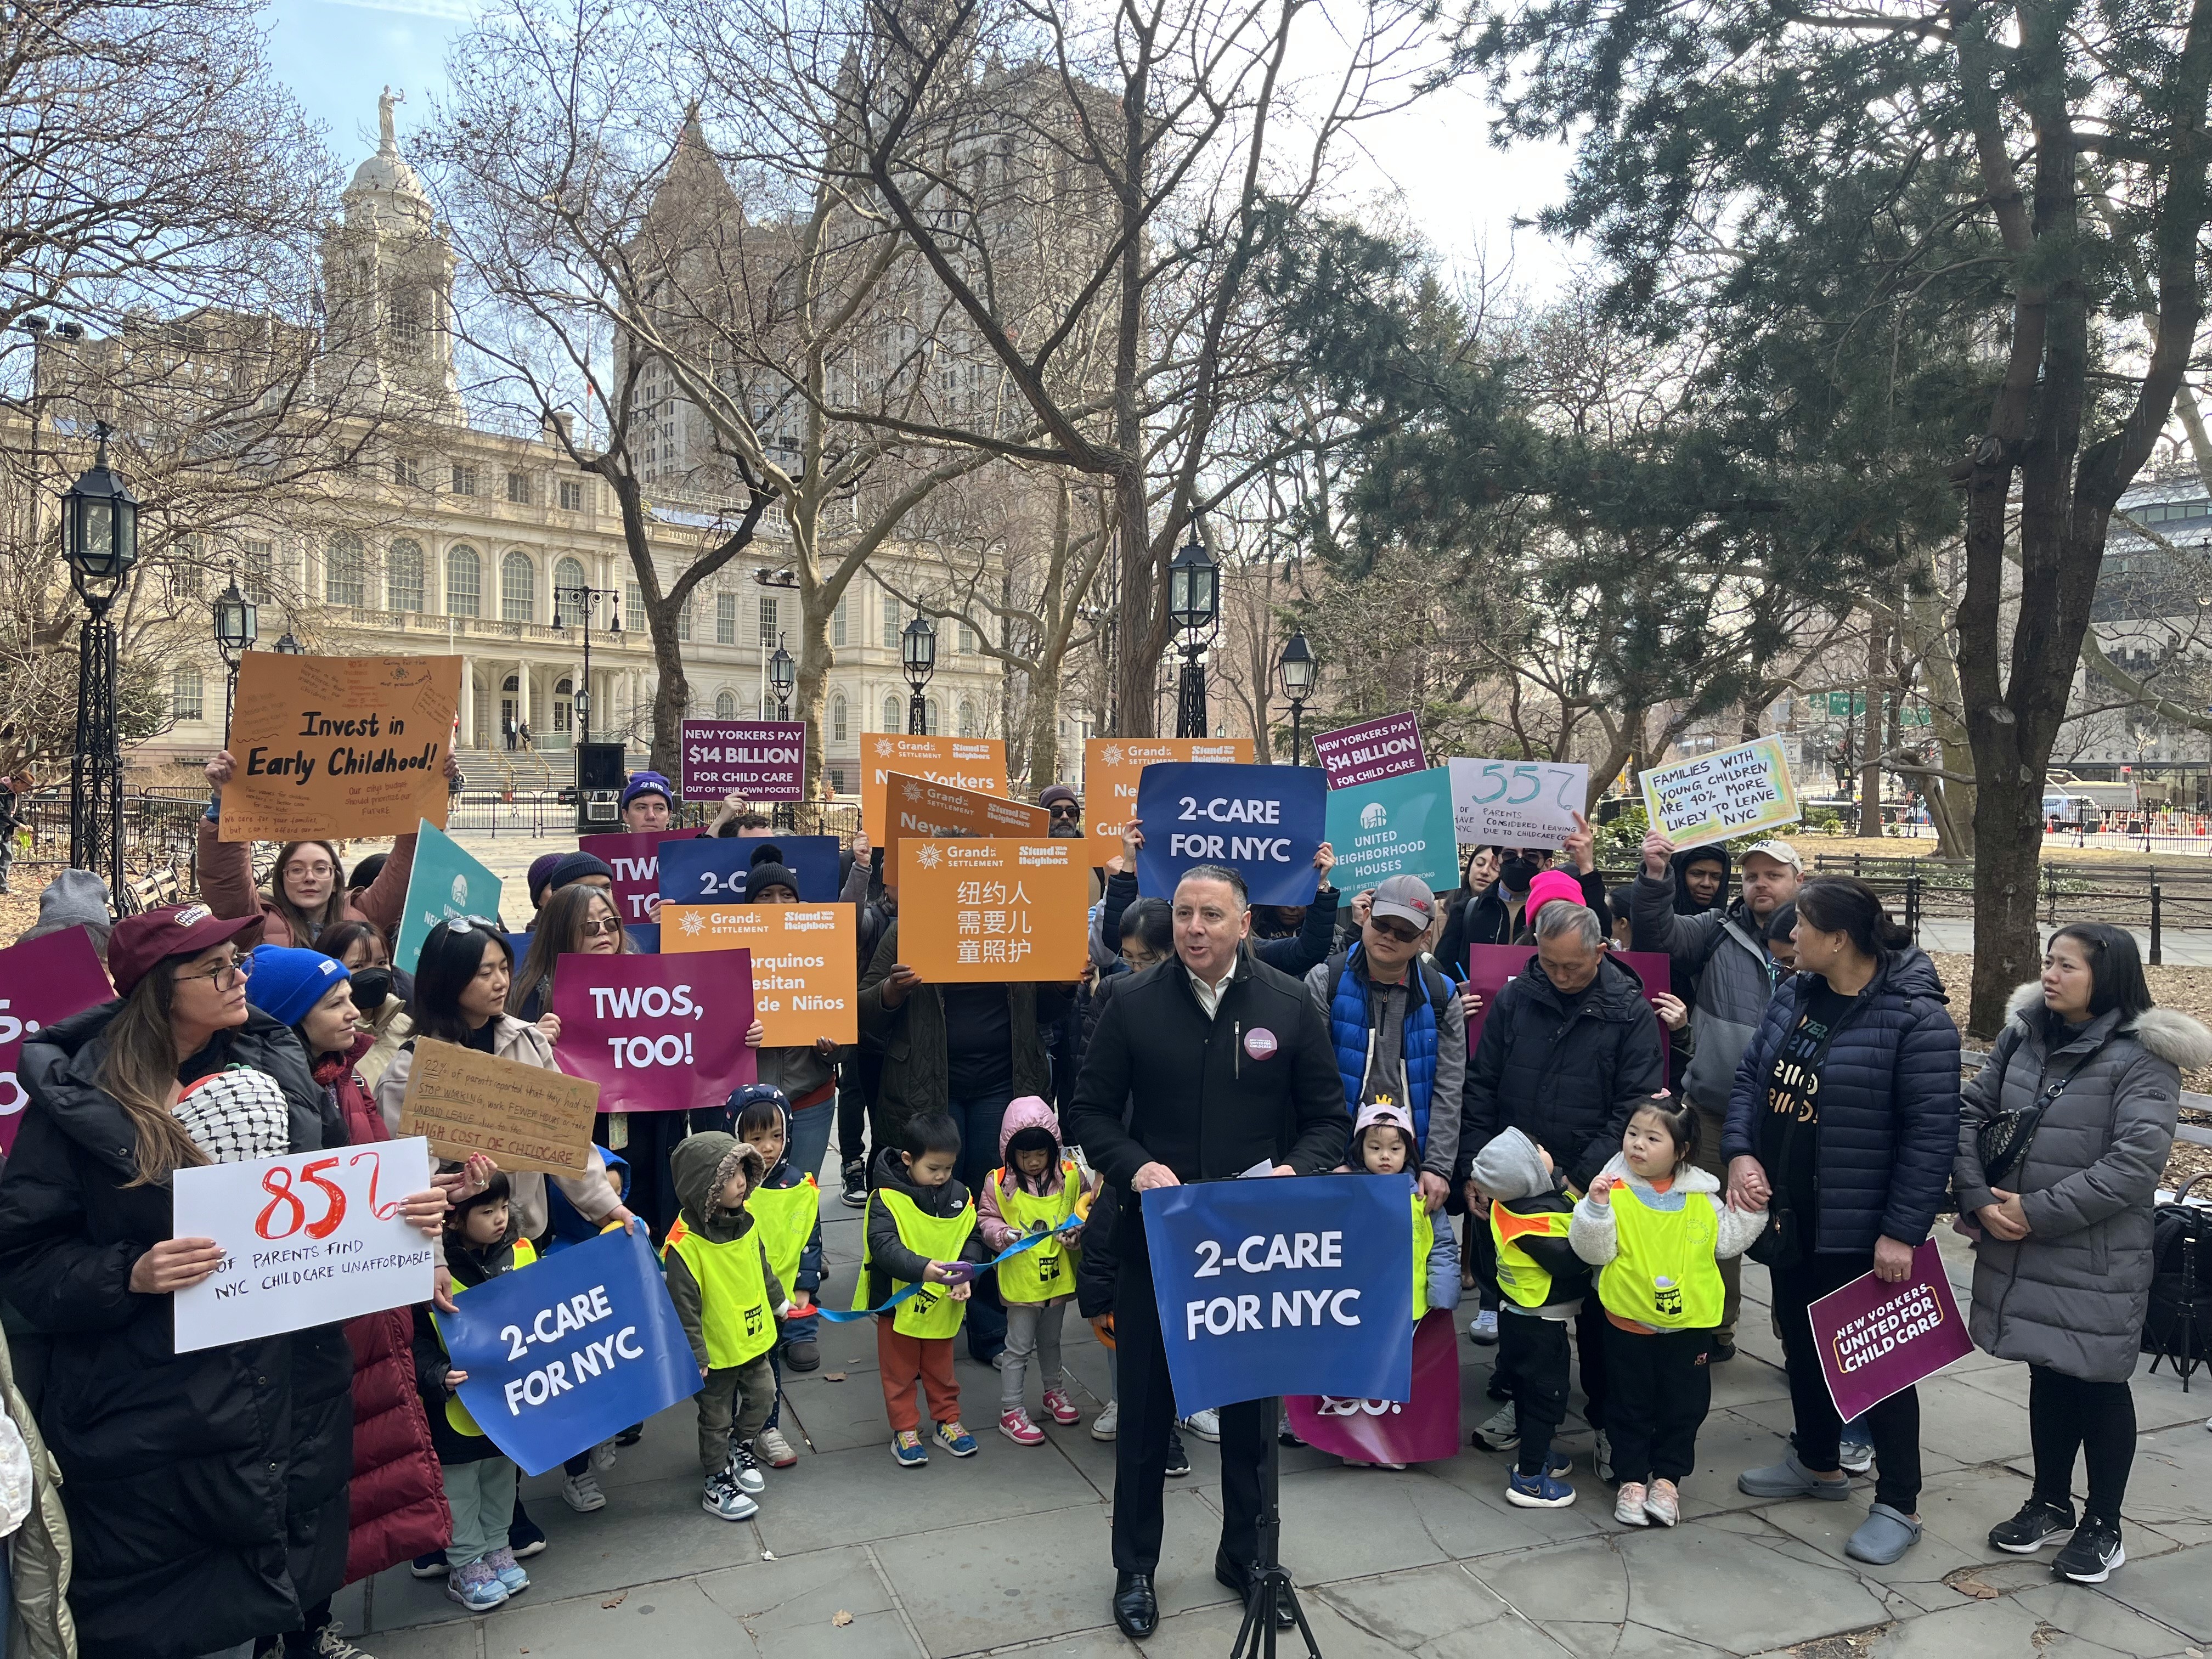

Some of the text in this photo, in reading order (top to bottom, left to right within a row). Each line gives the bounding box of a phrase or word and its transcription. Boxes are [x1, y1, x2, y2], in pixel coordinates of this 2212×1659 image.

[298, 712, 379, 737] Invest
[389, 716, 404, 735] in
[686, 730, 802, 741] NEW YORKERS PAY
[1318, 720, 1412, 752] NEW YORKERS PAY
[689, 744, 799, 764] $14 BILLION
[898, 741, 930, 751] Grand
[1128, 746, 1165, 756] Grand
[1192, 746, 1223, 754] Stand
[1327, 736, 1417, 772] $14 BILLION
[247, 743, 438, 786] Early Childhood!
[693, 772, 793, 782] FOR CHILD CARE
[1336, 775, 1356, 786] FOR
[1356, 767, 1384, 781] CHILD
[1386, 759, 1416, 772] CARE
[1652, 750, 1754, 788] FAMILIES WITH
[349, 780, 408, 795] Our budget
[924, 771, 995, 789] Yorkers
[1658, 781, 1702, 804] YOUNG
[1708, 761, 1768, 786] CHILDREN
[371, 794, 399, 805] prioritize
[927, 788, 963, 805] Grand
[1658, 778, 1767, 816] ARE 40% MORE
[1178, 797, 1280, 824] 2-CARE
[1483, 808, 1522, 819] PARENTS
[1666, 790, 1775, 832] LIKELY TO LEAVE
[1724, 809, 1757, 826] NYC
[230, 826, 241, 834] but
[1487, 818, 1537, 828] CONSIDERED
[1543, 823, 1576, 832] LEAVING
[1517, 831, 1555, 839] CHILDCARE
[947, 846, 989, 857] Grand
[1019, 846, 1054, 856] Stand
[1170, 833, 1291, 862] FOR NYC
[1355, 831, 1397, 847] UNITED
[1334, 840, 1426, 866] NEIGHBORHOOD
[1355, 860, 1402, 877] HOUSES
[957, 881, 1031, 905] 纽约人
[711, 912, 753, 924] Grand
[785, 911, 820, 921] Stand
[957, 910, 1032, 934] 需要儿
[712, 926, 769, 934] SETTLEMENT
[957, 939, 1031, 963] 童照护
[589, 985, 704, 1020] TWOS,
[757, 995, 844, 1011] de Niños
[608, 1032, 694, 1069] TOO!
[424, 1059, 447, 1074] 22%
[452, 1069, 464, 1080] of
[466, 1074, 492, 1086] parents
[493, 1080, 522, 1094] reported
[525, 1082, 544, 1097] that
[547, 1088, 561, 1107] they
[563, 1092, 579, 1110] had
[414, 1103, 522, 1135] UNPAID LEAVE due to the
[418, 1083, 439, 1095] STOP
[488, 1099, 505, 1111] work
[509, 1101, 538, 1119] FEWER
[539, 1112, 560, 1125] HOURS
[572, 1116, 586, 1132] take
[414, 1120, 574, 1165] HIGH COST OF CHILDCARE
[216, 1240, 363, 1273] OF PARENTS FIND
[1194, 1231, 1342, 1278] 2-CARE
[215, 1249, 433, 1300] NYC CHILDCARE UNAFFORDABLE
[500, 1284, 613, 1362] 2-CARE
[1186, 1288, 1361, 1341] FOR NYC
[1837, 1283, 1927, 1339] NEW YORKERS
[1839, 1297, 1934, 1355] UNITED FOR
[1845, 1311, 1940, 1372] CHILD CARE
[504, 1326, 644, 1416] FOR NYC
